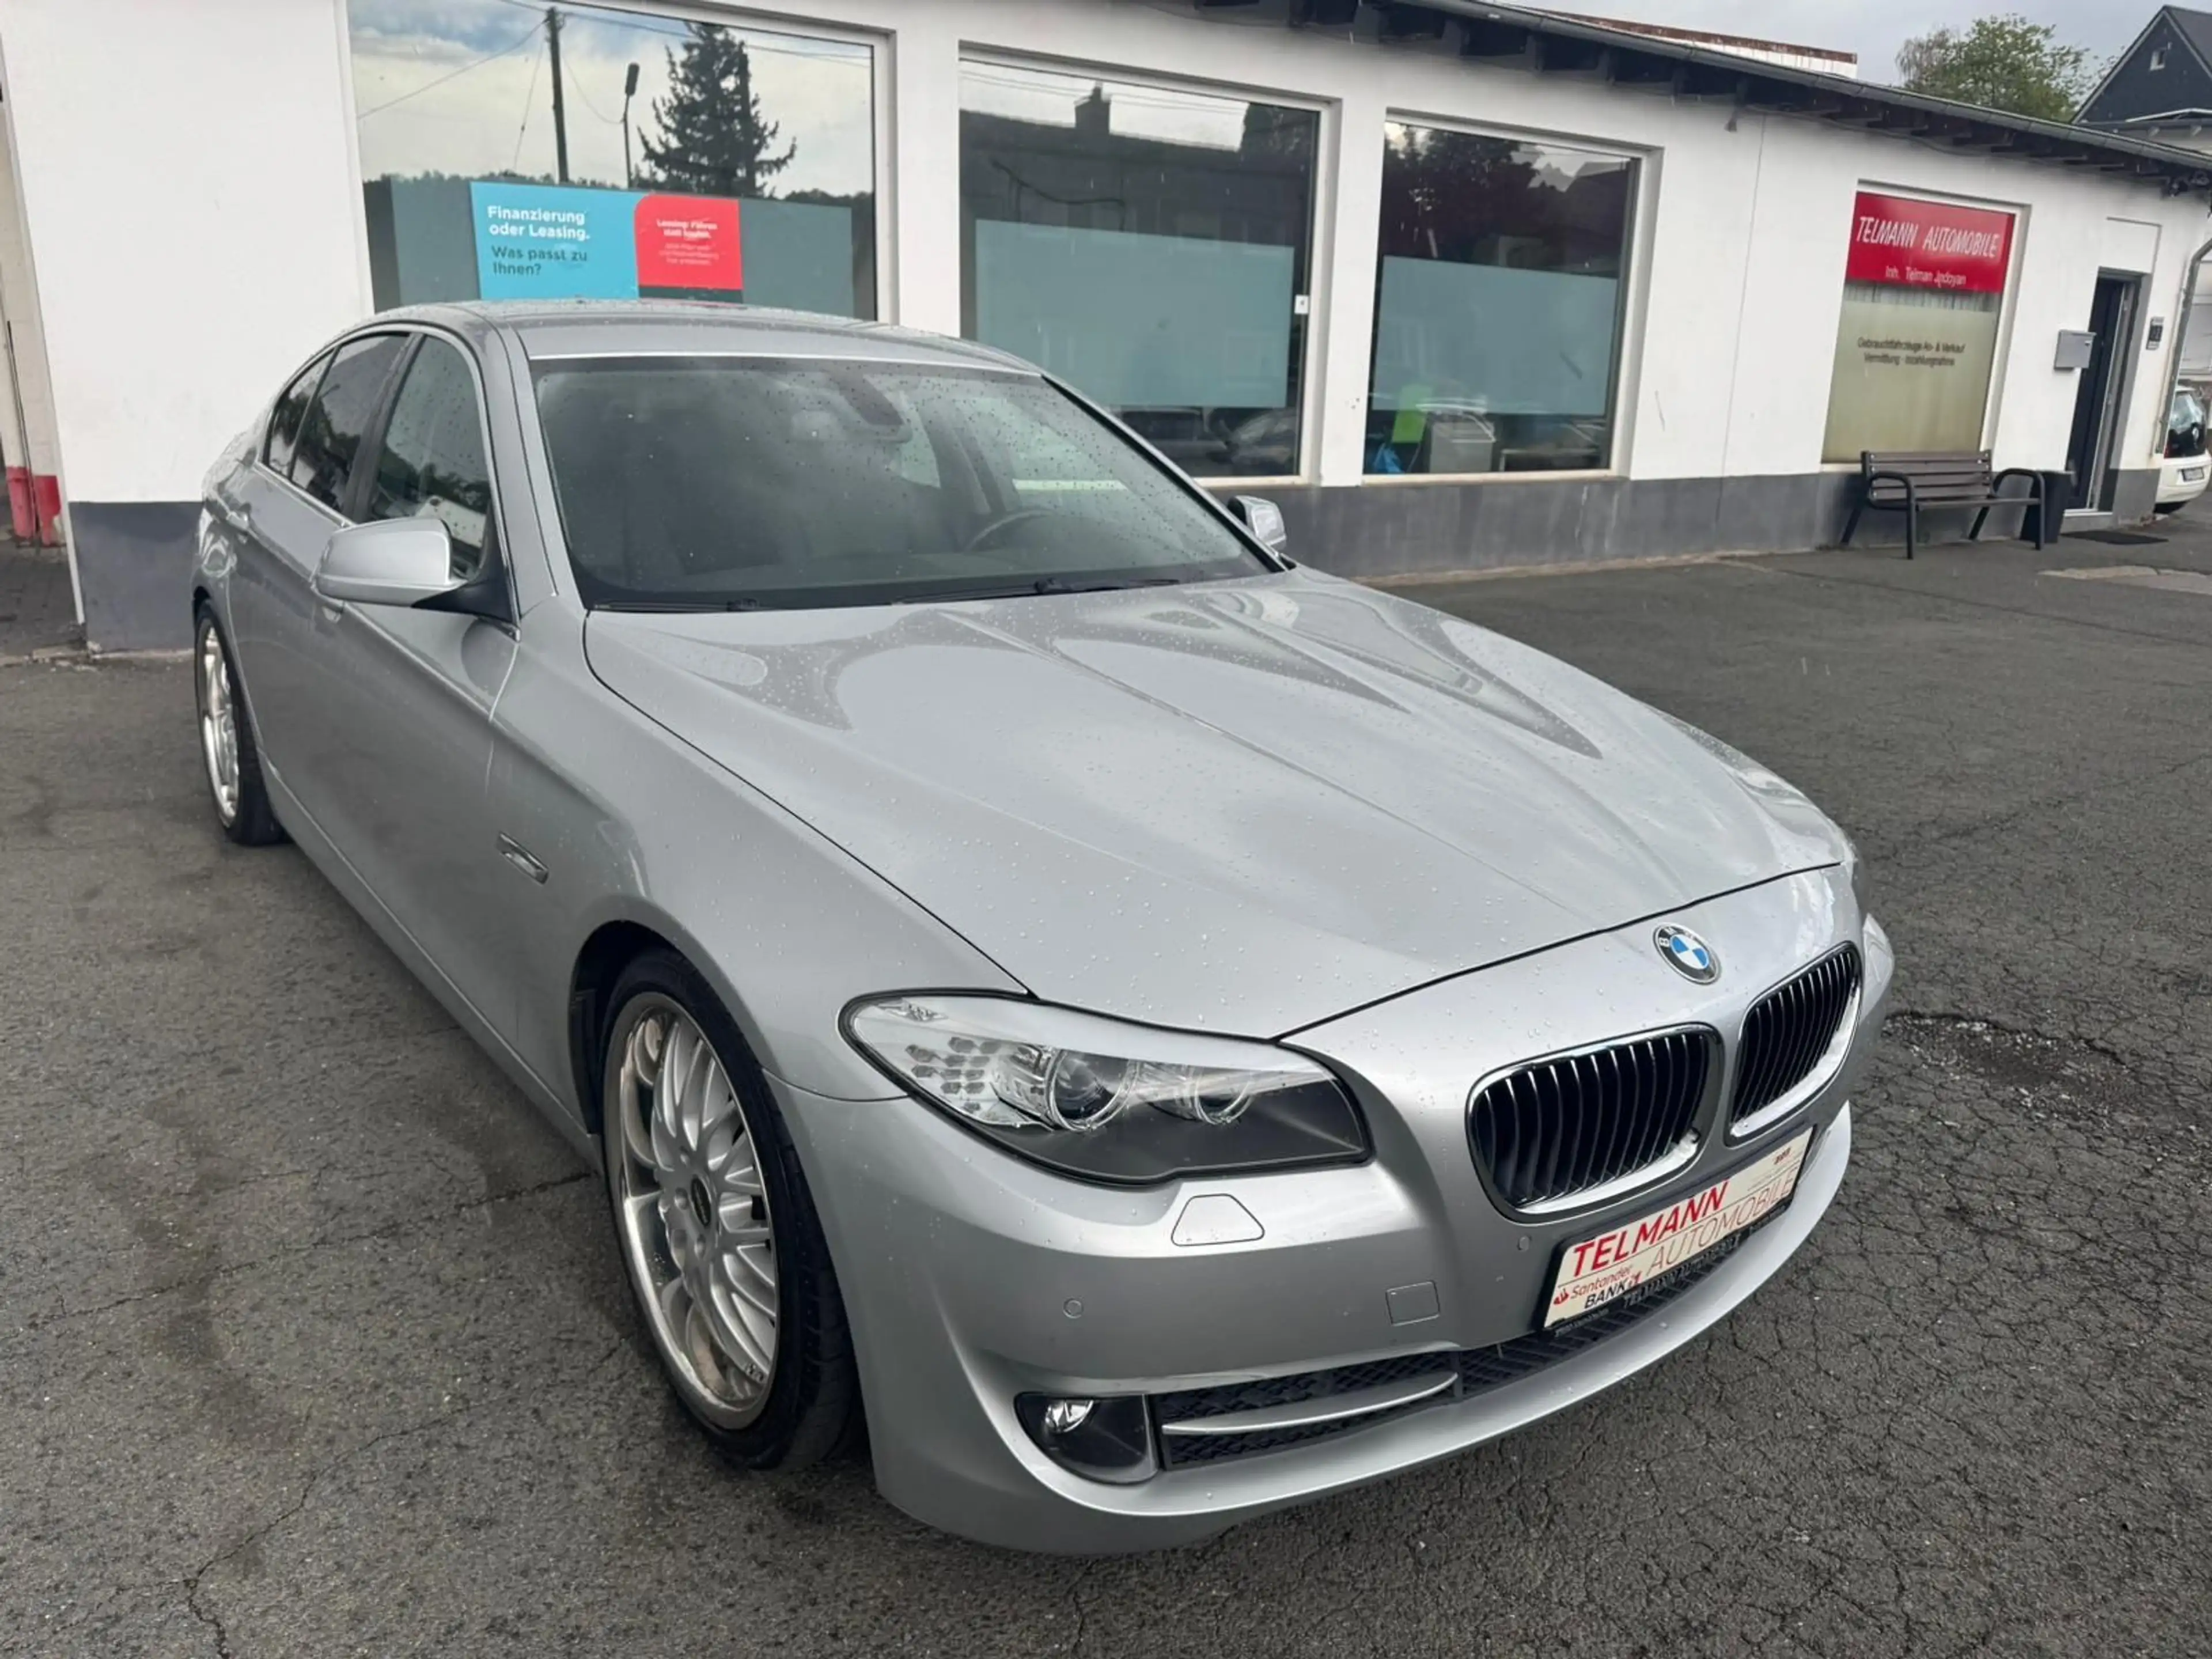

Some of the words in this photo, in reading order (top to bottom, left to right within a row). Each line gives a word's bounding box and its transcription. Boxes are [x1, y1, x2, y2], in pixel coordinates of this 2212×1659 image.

[487, 205, 586, 225] Finanzierung
[489, 223, 525, 237] oder
[528, 224, 590, 241] Leasing.
[1856, 217, 1919, 248] TELMANN
[1922, 226, 2001, 258] AUTOMOBILE
[491, 245, 524, 260] Was
[528, 247, 566, 262] passt
[571, 251, 588, 262] zu
[493, 262, 541, 275] Ihnen?
[1573, 1180, 1728, 1277] TELMANN
[1646, 1165, 1799, 1277] AUTOMOBILE
[1571, 1265, 1633, 1298] Santander
[1585, 1277, 1628, 1308] BANK
